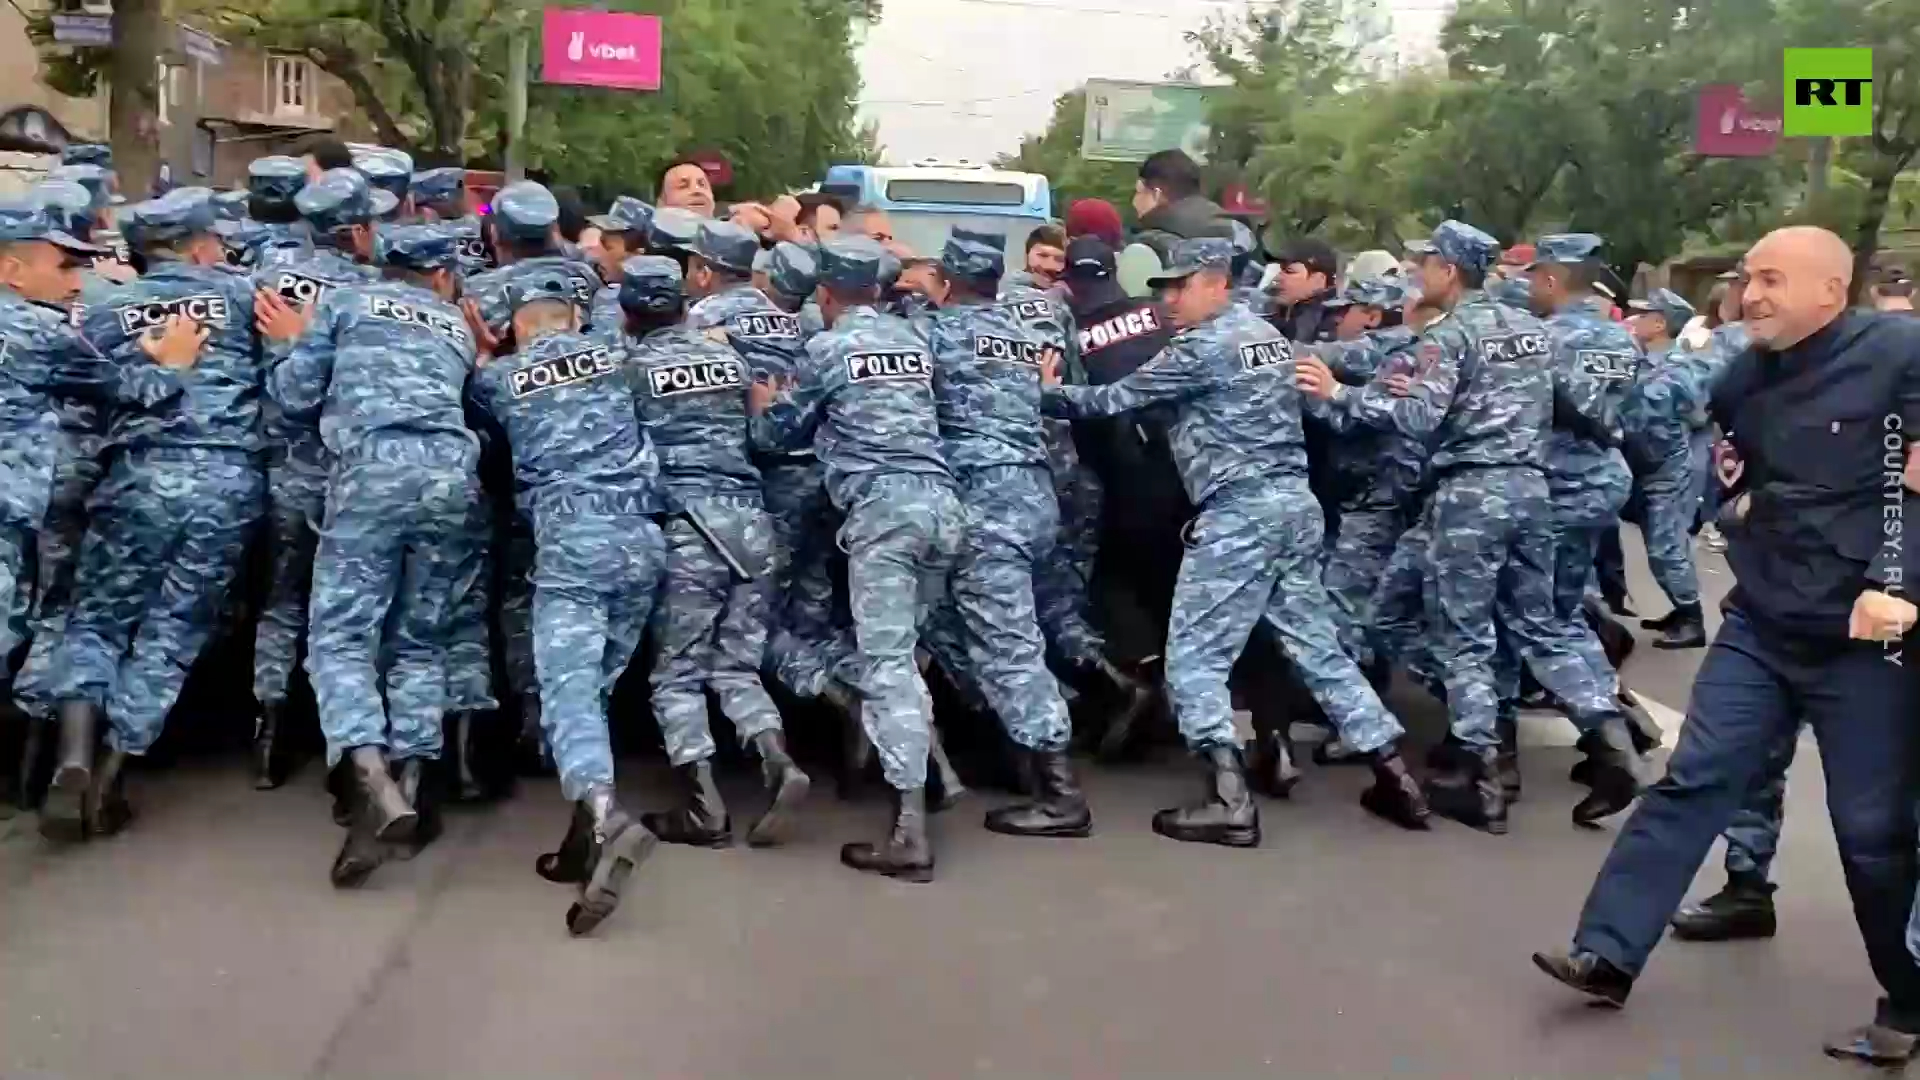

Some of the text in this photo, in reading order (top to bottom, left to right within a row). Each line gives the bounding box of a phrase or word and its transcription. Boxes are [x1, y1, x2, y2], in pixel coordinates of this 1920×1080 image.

[1079, 308, 1157, 354] POLICE
[514, 349, 613, 393] POLICE
[655, 362, 738, 391] POLICE
